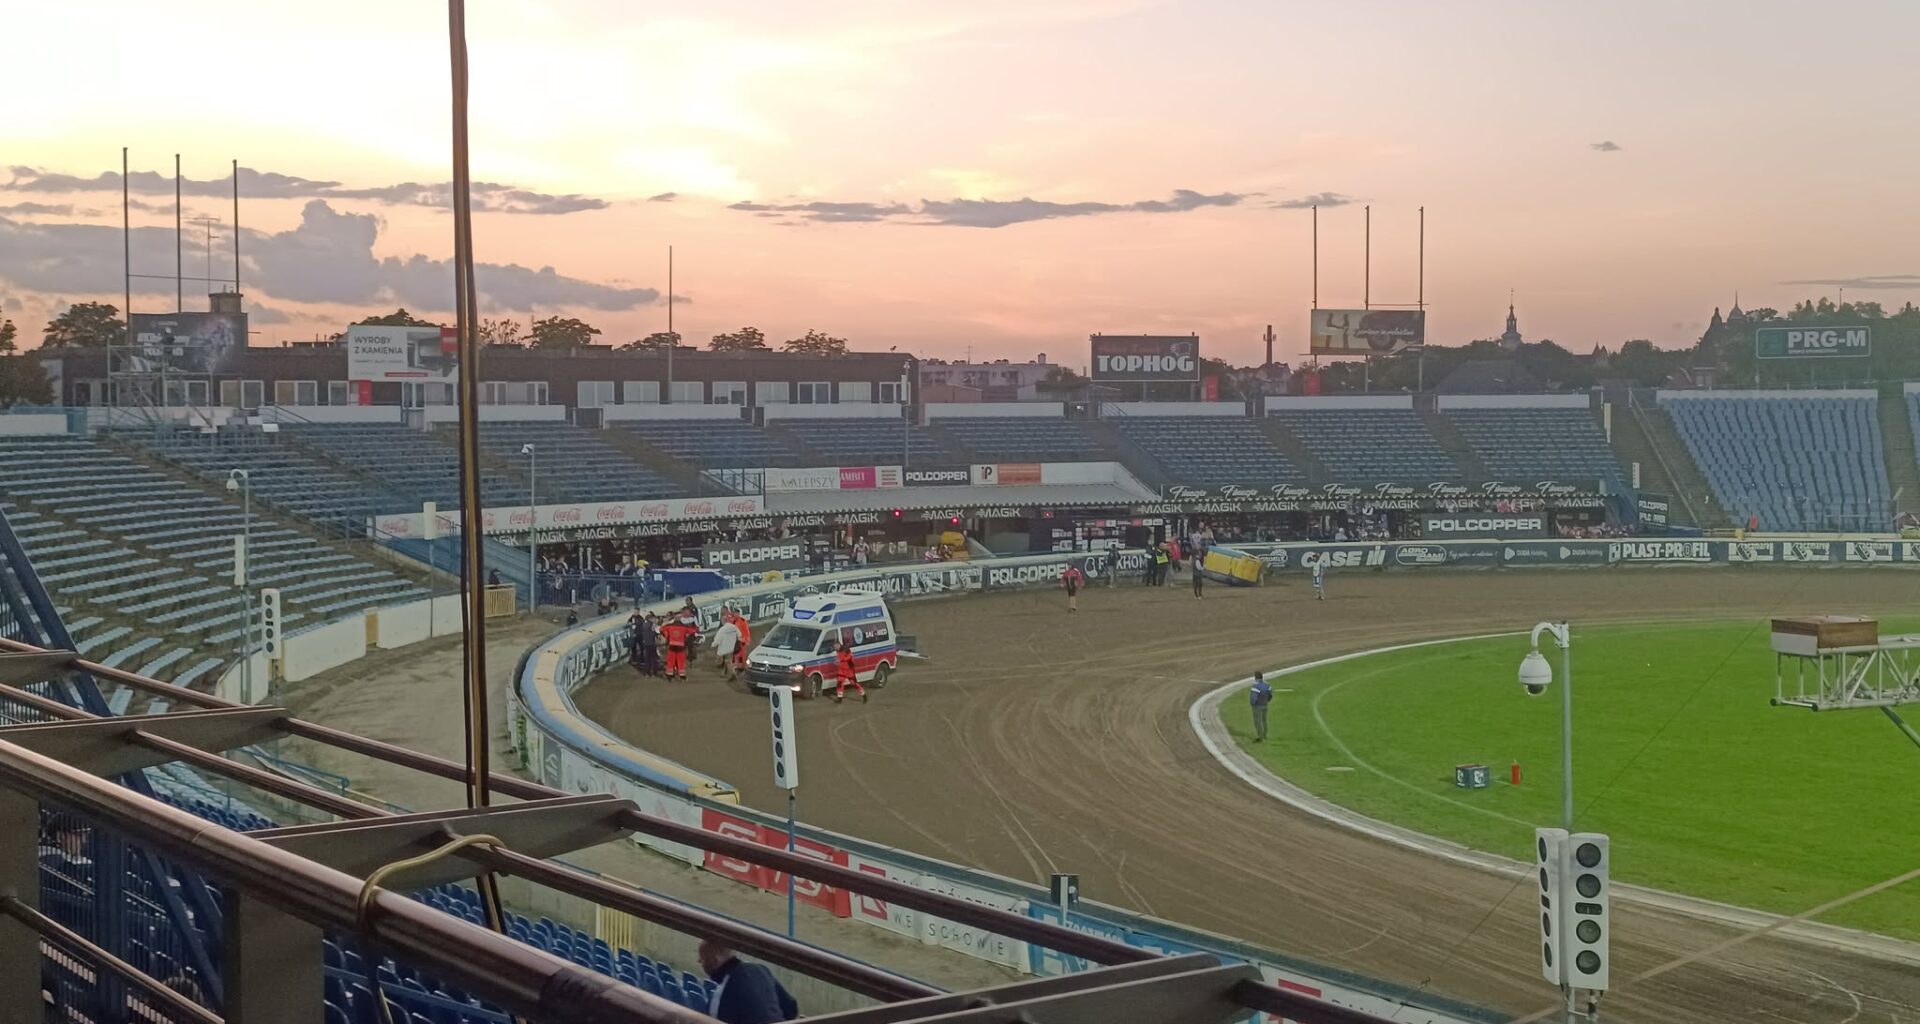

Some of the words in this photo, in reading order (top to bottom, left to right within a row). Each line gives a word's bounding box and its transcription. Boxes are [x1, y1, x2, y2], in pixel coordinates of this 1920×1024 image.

[354, 336, 391, 344] WYROBY
[1788, 330, 1866, 348] PRG-M
[1097, 355, 1194, 372] TOPHOG
[840, 472, 865, 481] AMBIT
[906, 471, 968, 481] POLCOPPER
[597, 505, 626, 519] Coca-Cola
[641, 503, 668, 517] Coca-Cola
[684, 501, 713, 515] Coca-Cola
[728, 499, 756, 513] Coca-Cola
[509, 511, 538, 525] Coca-Cola
[553, 508, 581, 521] Coca-Cola
[1429, 519, 1542, 532] POLCOPPER
[709, 545, 800, 565] POLCOPPER
[1622, 543, 1710, 558] PLAST-PROFIL
[1301, 551, 1362, 567] CASE
[989, 563, 1069, 585] POLCOPPE
[893, 912, 913, 928] WE
